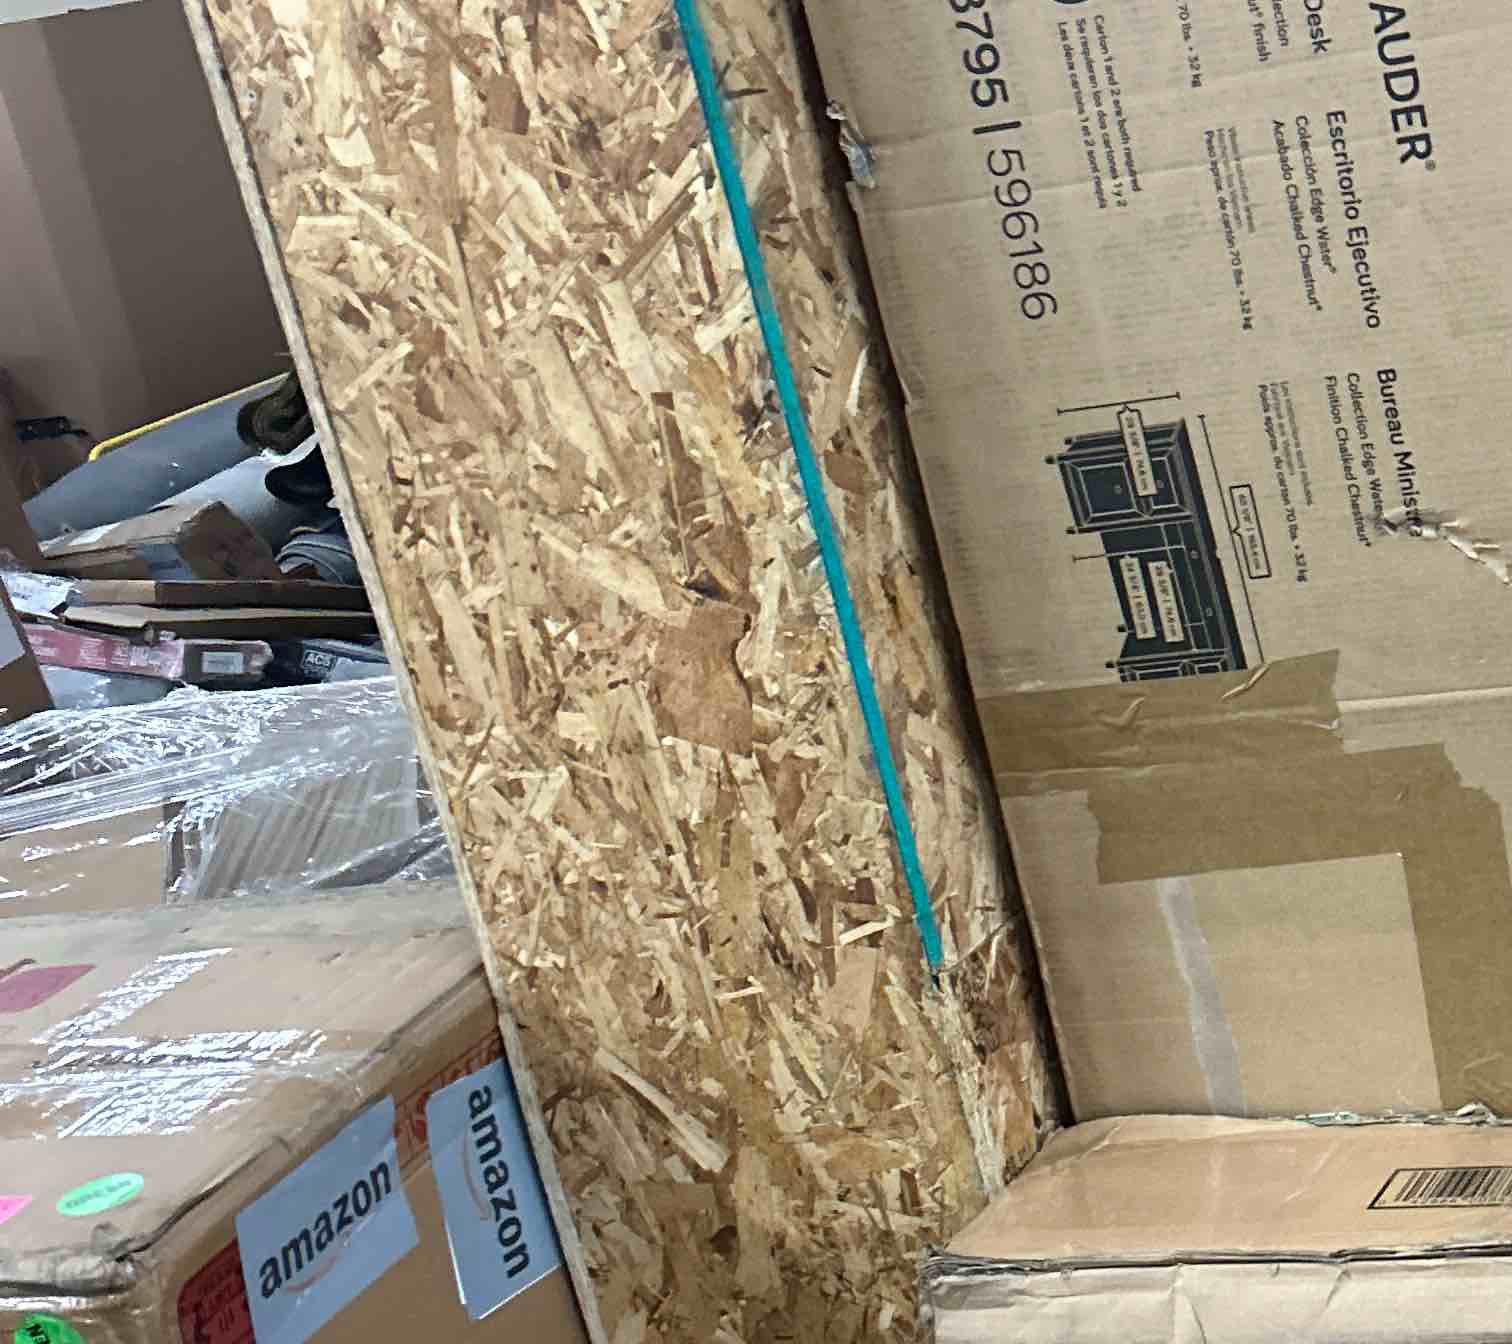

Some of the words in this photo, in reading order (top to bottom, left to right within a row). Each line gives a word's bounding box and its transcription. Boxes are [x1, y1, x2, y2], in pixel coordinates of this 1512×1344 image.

[1178, 3, 1190, 21] 70
[1253, 22, 1271, 62] finish
[1094, 15, 1108, 54] Carton
[1105, 65, 1118, 86] and
[1117, 117, 1130, 144] both
[1273, 120, 1293, 180] Acabado
[1285, 184, 1307, 240] Chalked
[1296, 116, 1317, 185] Colección
[1310, 188, 1324, 223] Edge
[1327, 111, 1360, 219] Escritorio
[1347, 227, 1380, 328] Ejecutivo
[988, 150, 1056, 319] 596186
[1325, 376, 1342, 424] Finition
[1336, 427, 1357, 480] Chalked
[1347, 373, 1368, 439] Collection
[1361, 443, 1376, 475] Edge
[1377, 369, 1403, 445] Bureau
[258, 1161, 392, 1300] amazon
[467, 1085, 531, 1279] amazon
